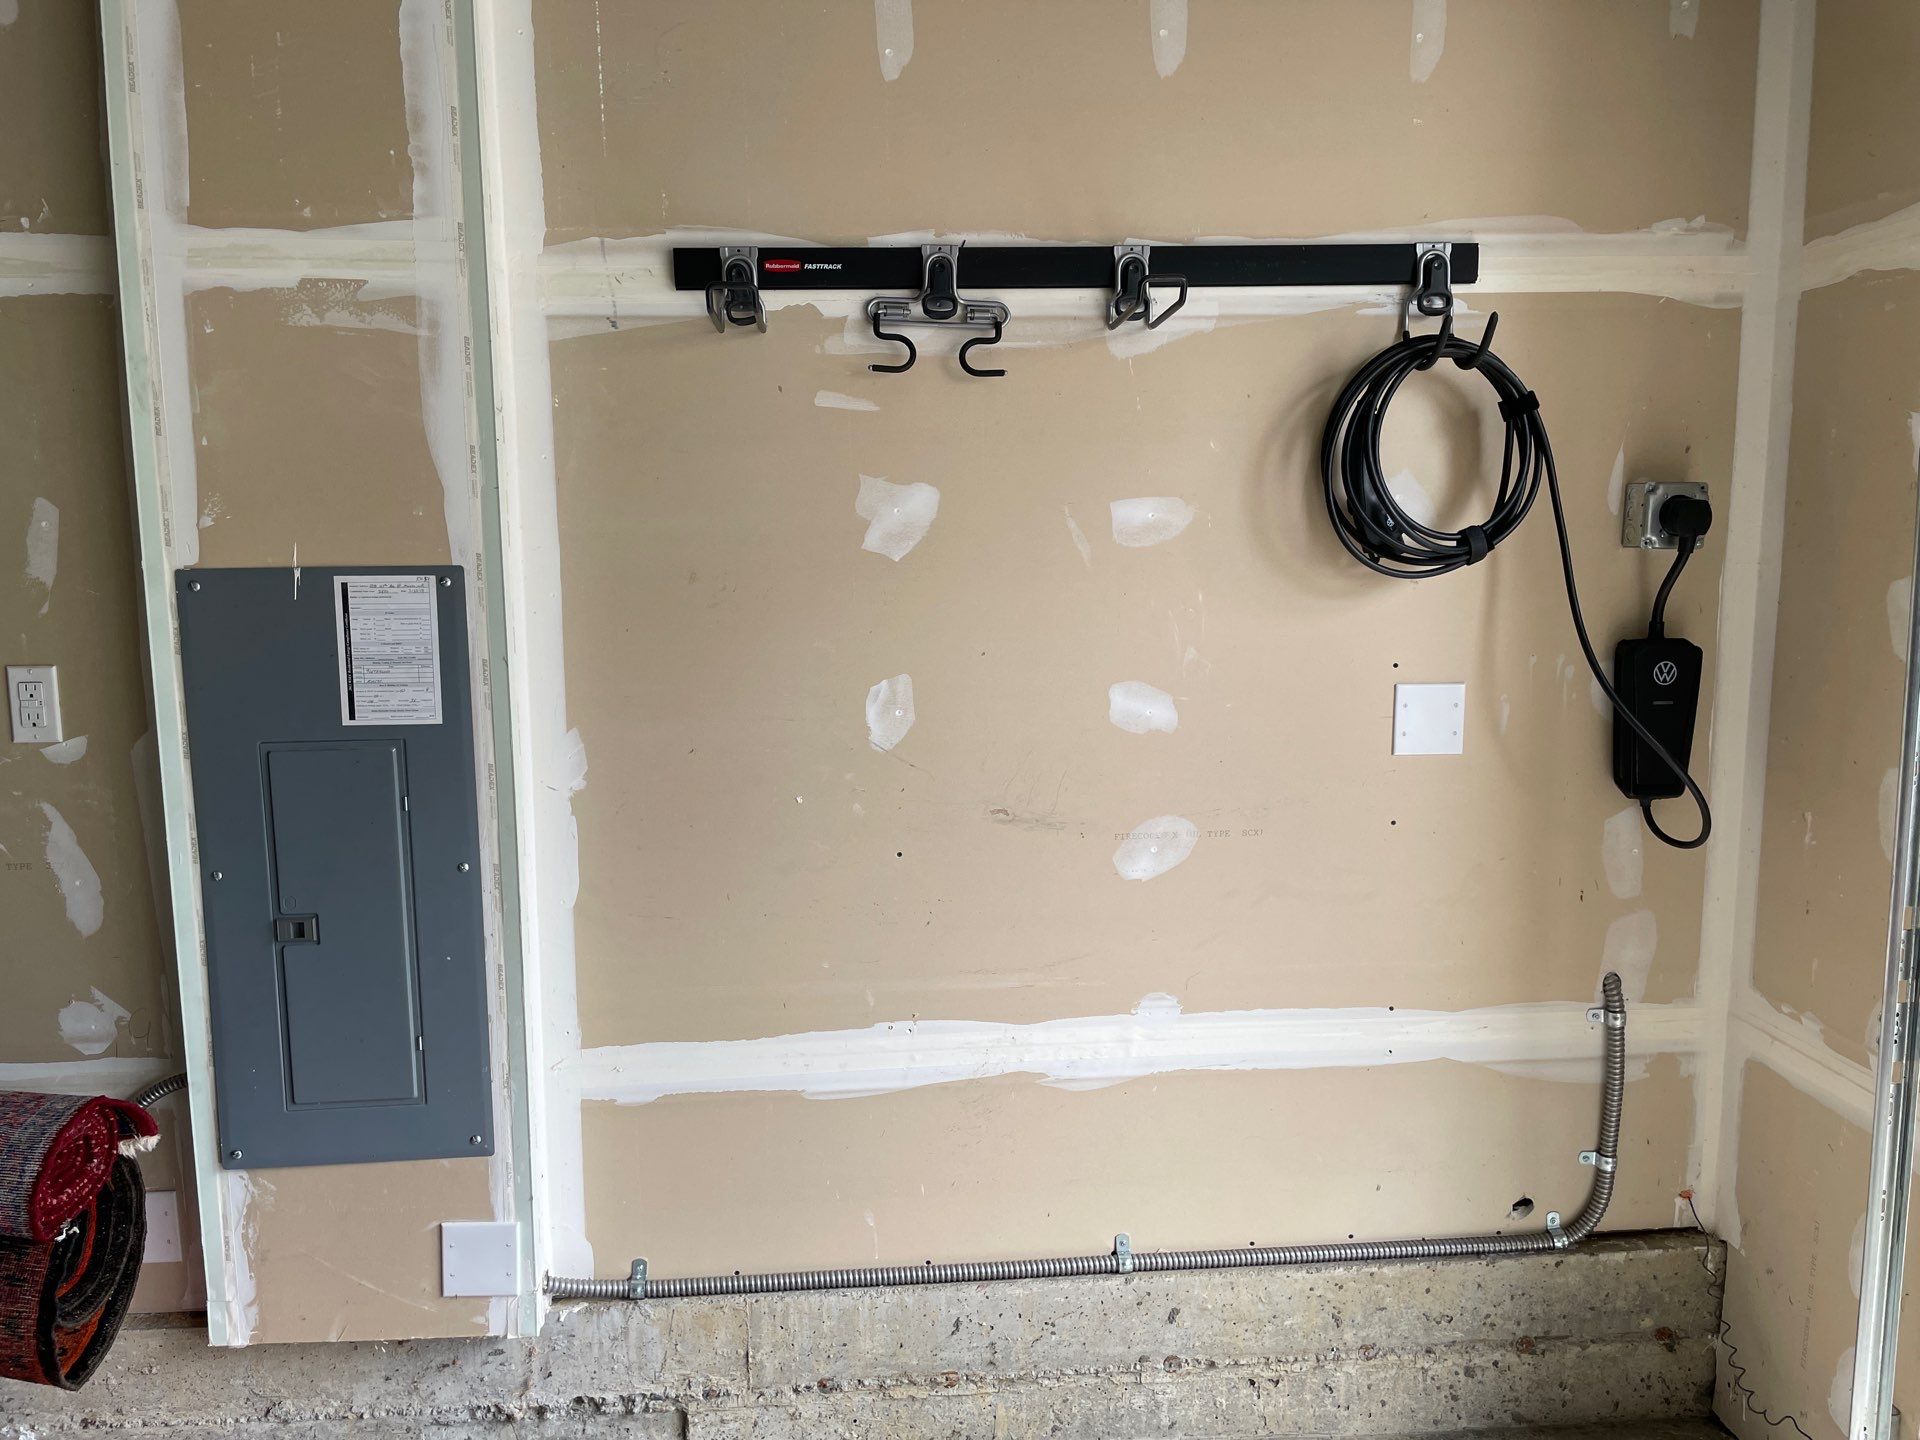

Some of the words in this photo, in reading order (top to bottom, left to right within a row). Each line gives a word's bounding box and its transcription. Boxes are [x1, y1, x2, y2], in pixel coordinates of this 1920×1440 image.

[469, 445, 477, 474] BEADEX
[1207, 829, 1231, 838] TYPE
[6, 862, 33, 871] TYPE
